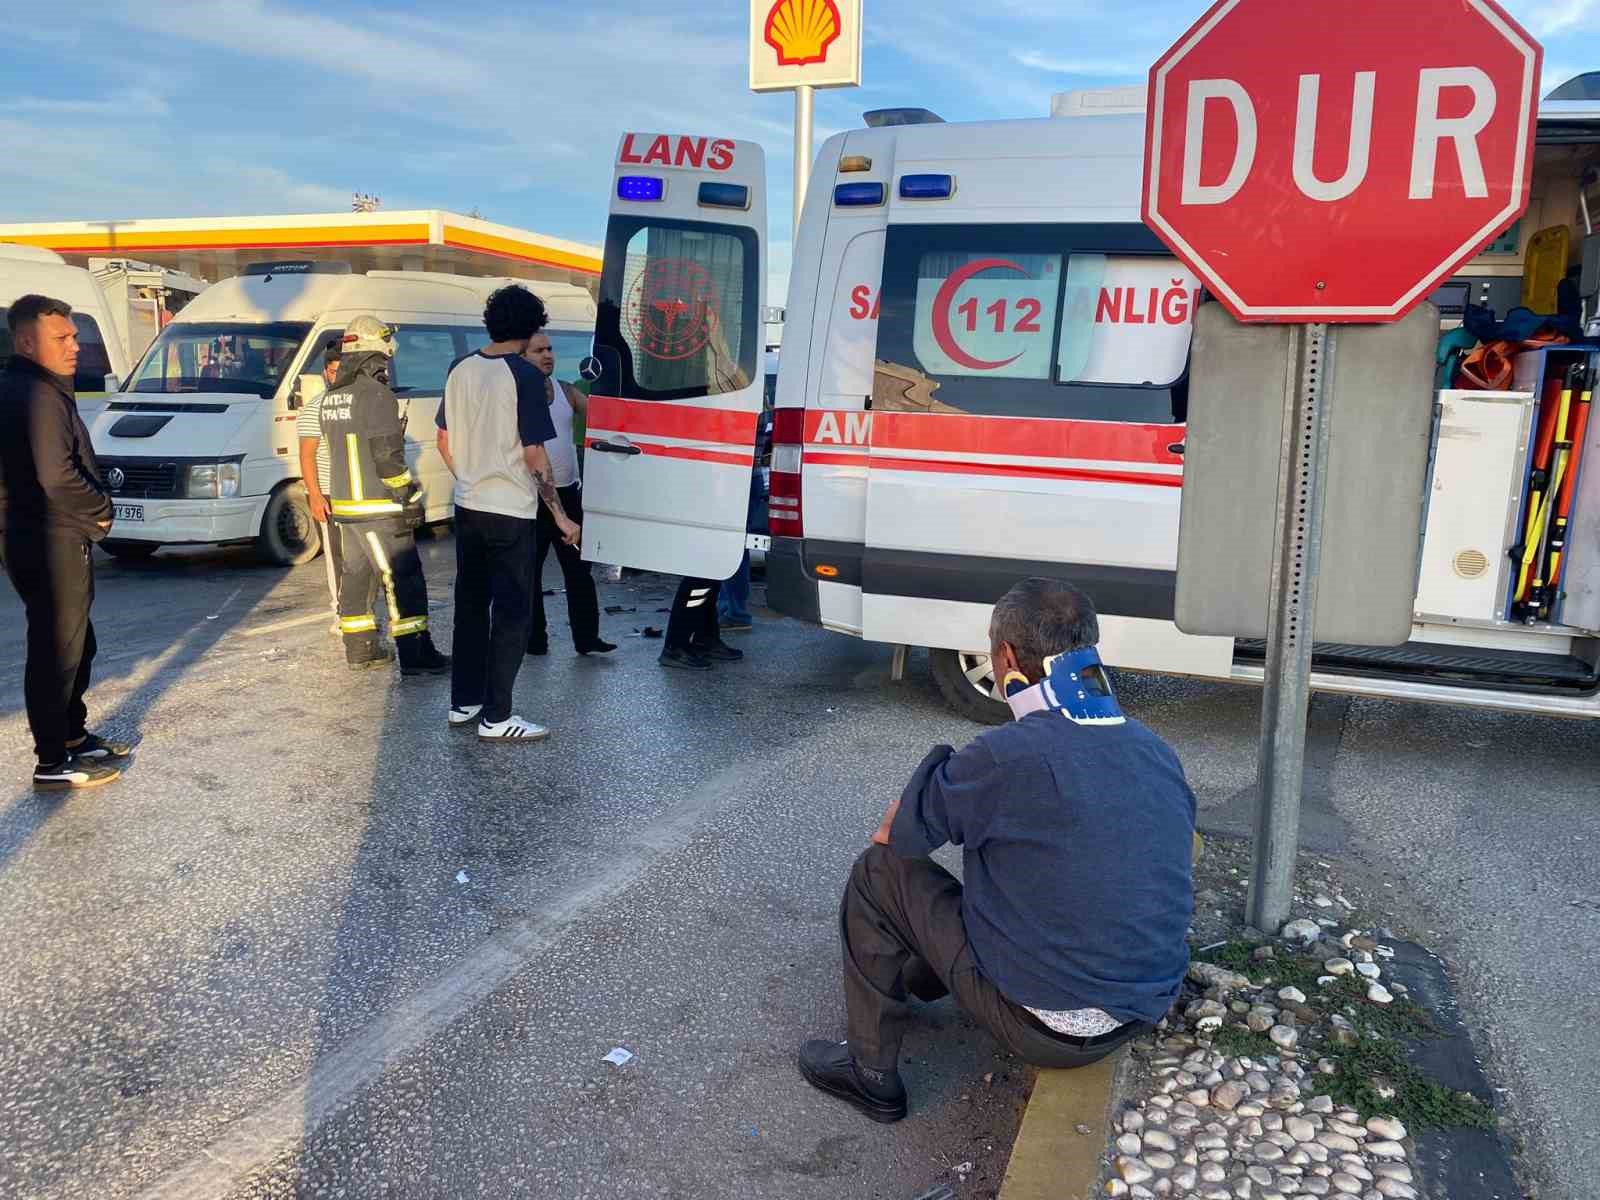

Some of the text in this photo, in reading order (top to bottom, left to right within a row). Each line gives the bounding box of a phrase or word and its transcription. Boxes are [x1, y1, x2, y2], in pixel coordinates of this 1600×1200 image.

[620, 133, 736, 171] LANS
[1181, 66, 1497, 205] DUR
[957, 297, 1042, 333] 112
[814, 411, 873, 444] AM
[125, 507, 142, 519] 976
